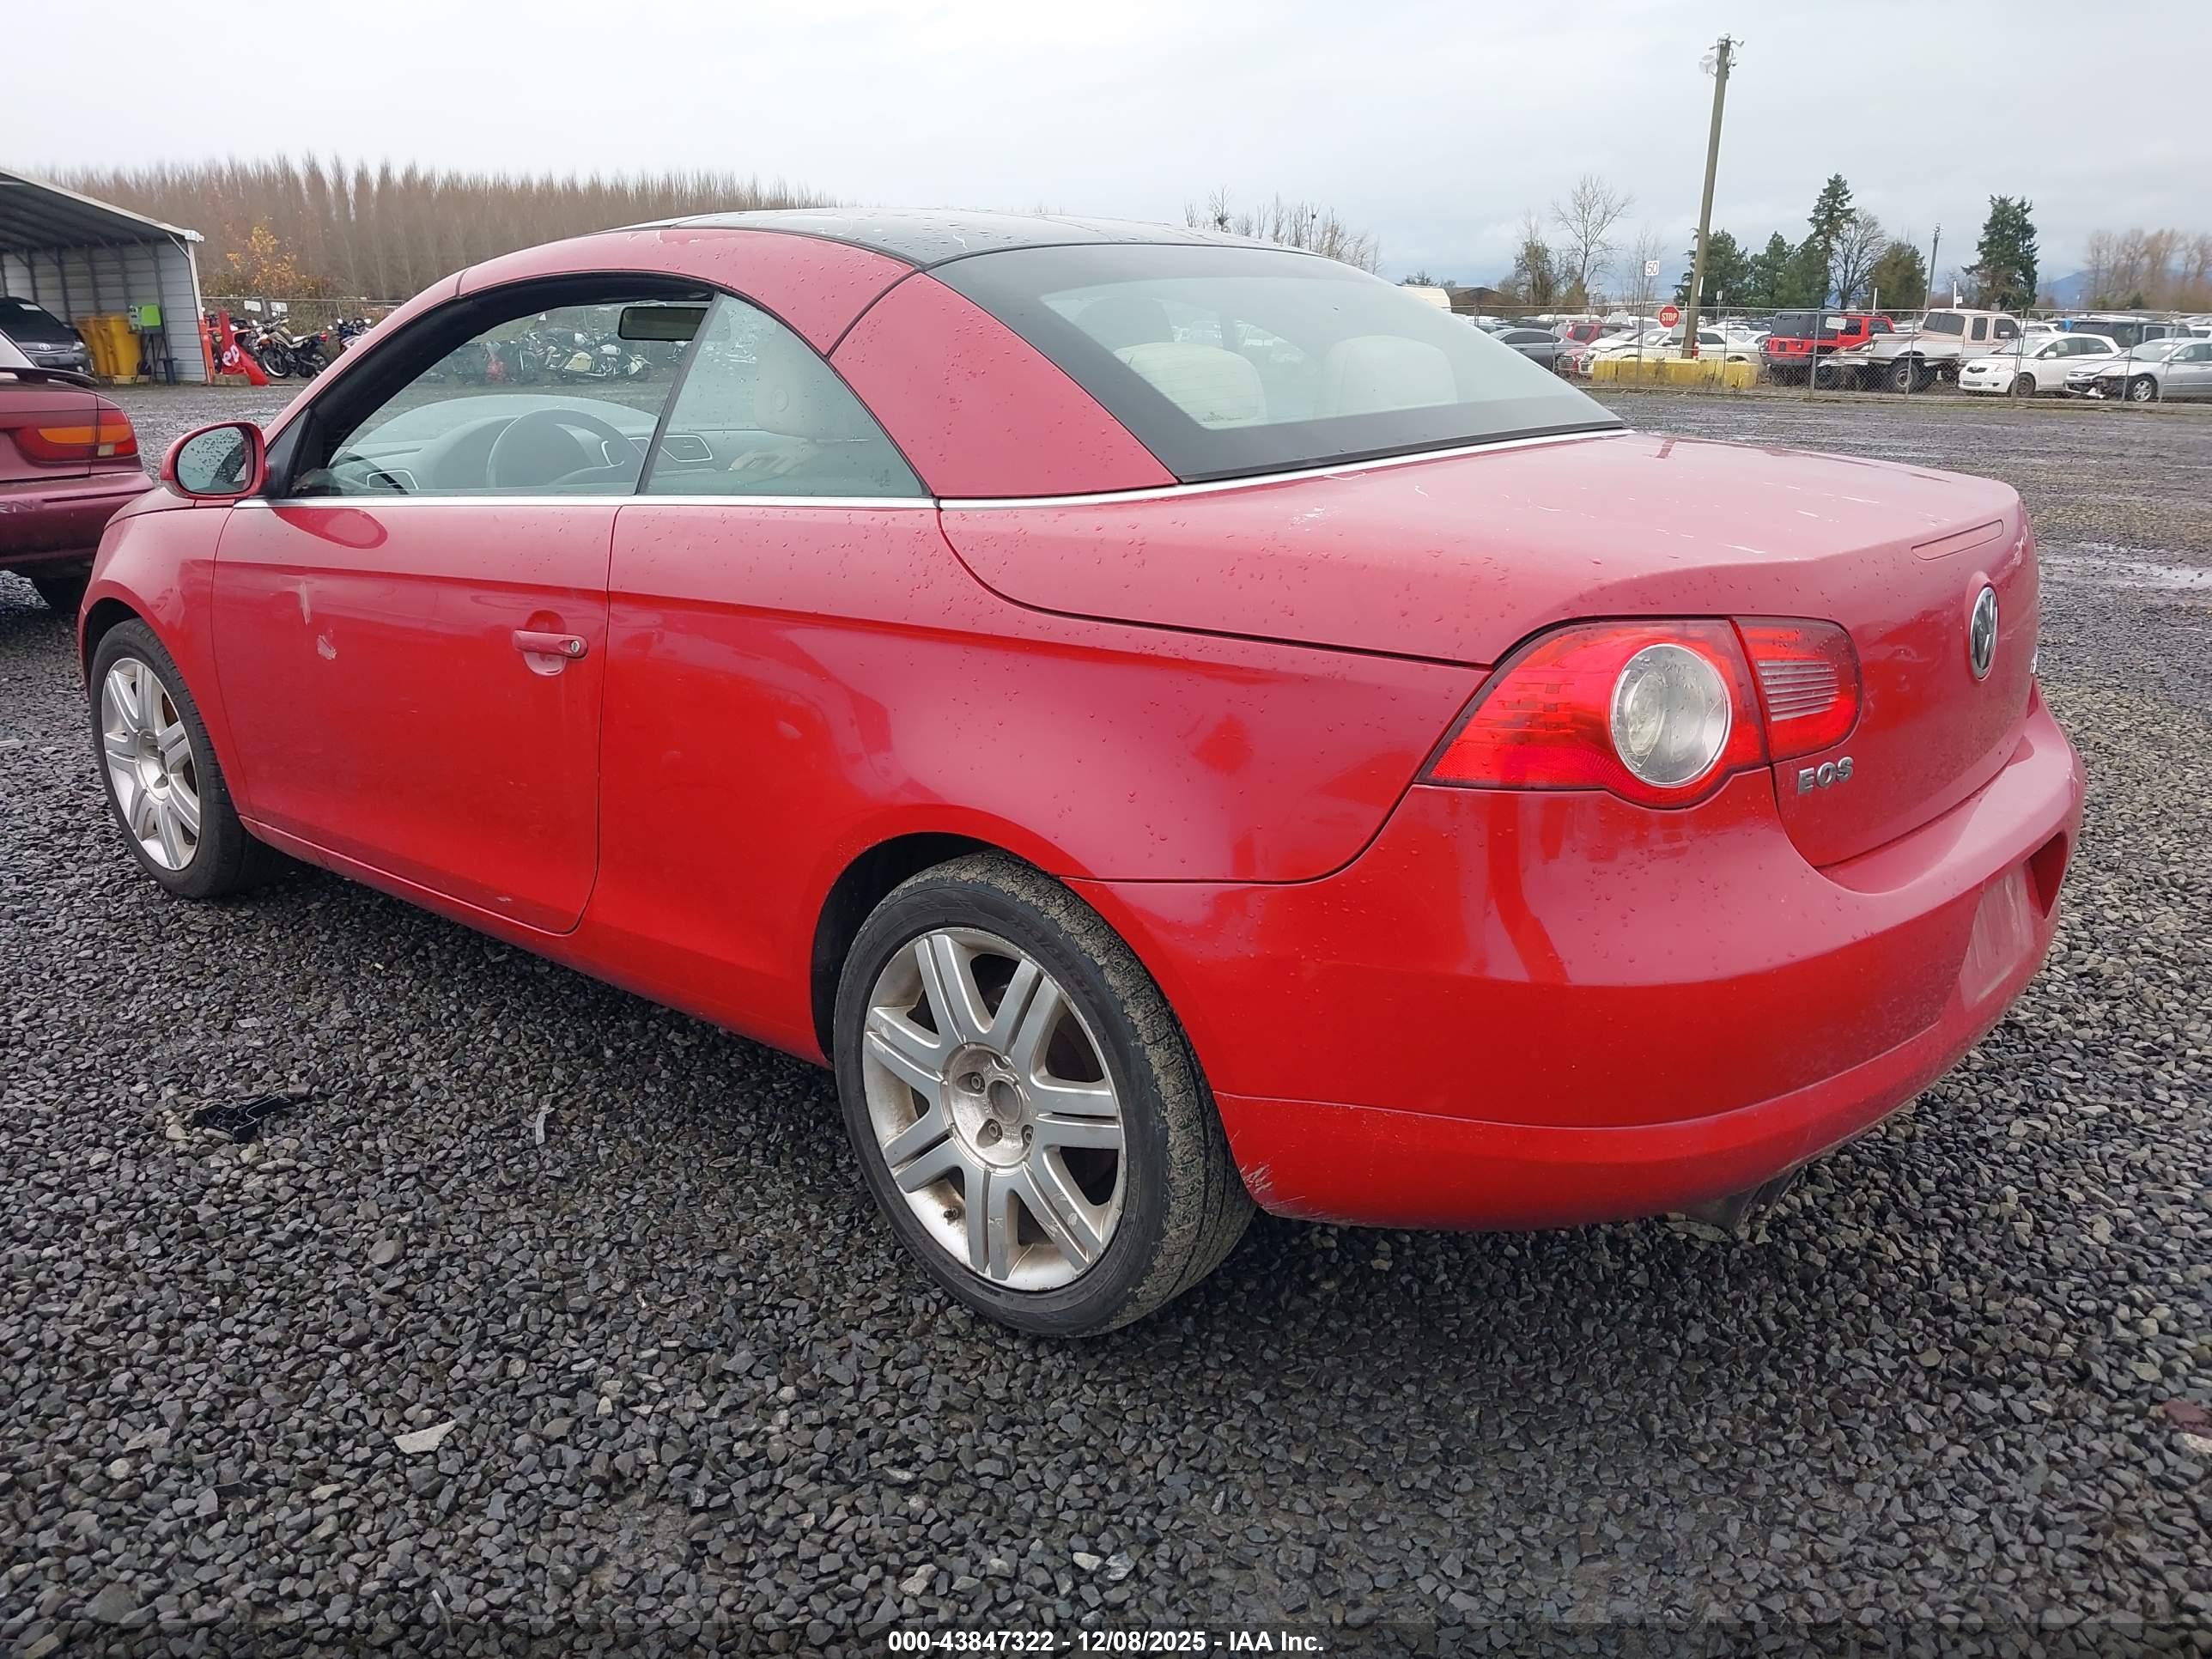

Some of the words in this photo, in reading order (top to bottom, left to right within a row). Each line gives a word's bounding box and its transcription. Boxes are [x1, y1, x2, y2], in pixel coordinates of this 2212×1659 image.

[1647, 262, 1658, 275] 50
[1661, 313, 1678, 322] STOP
[1798, 756, 1855, 794] EOS
